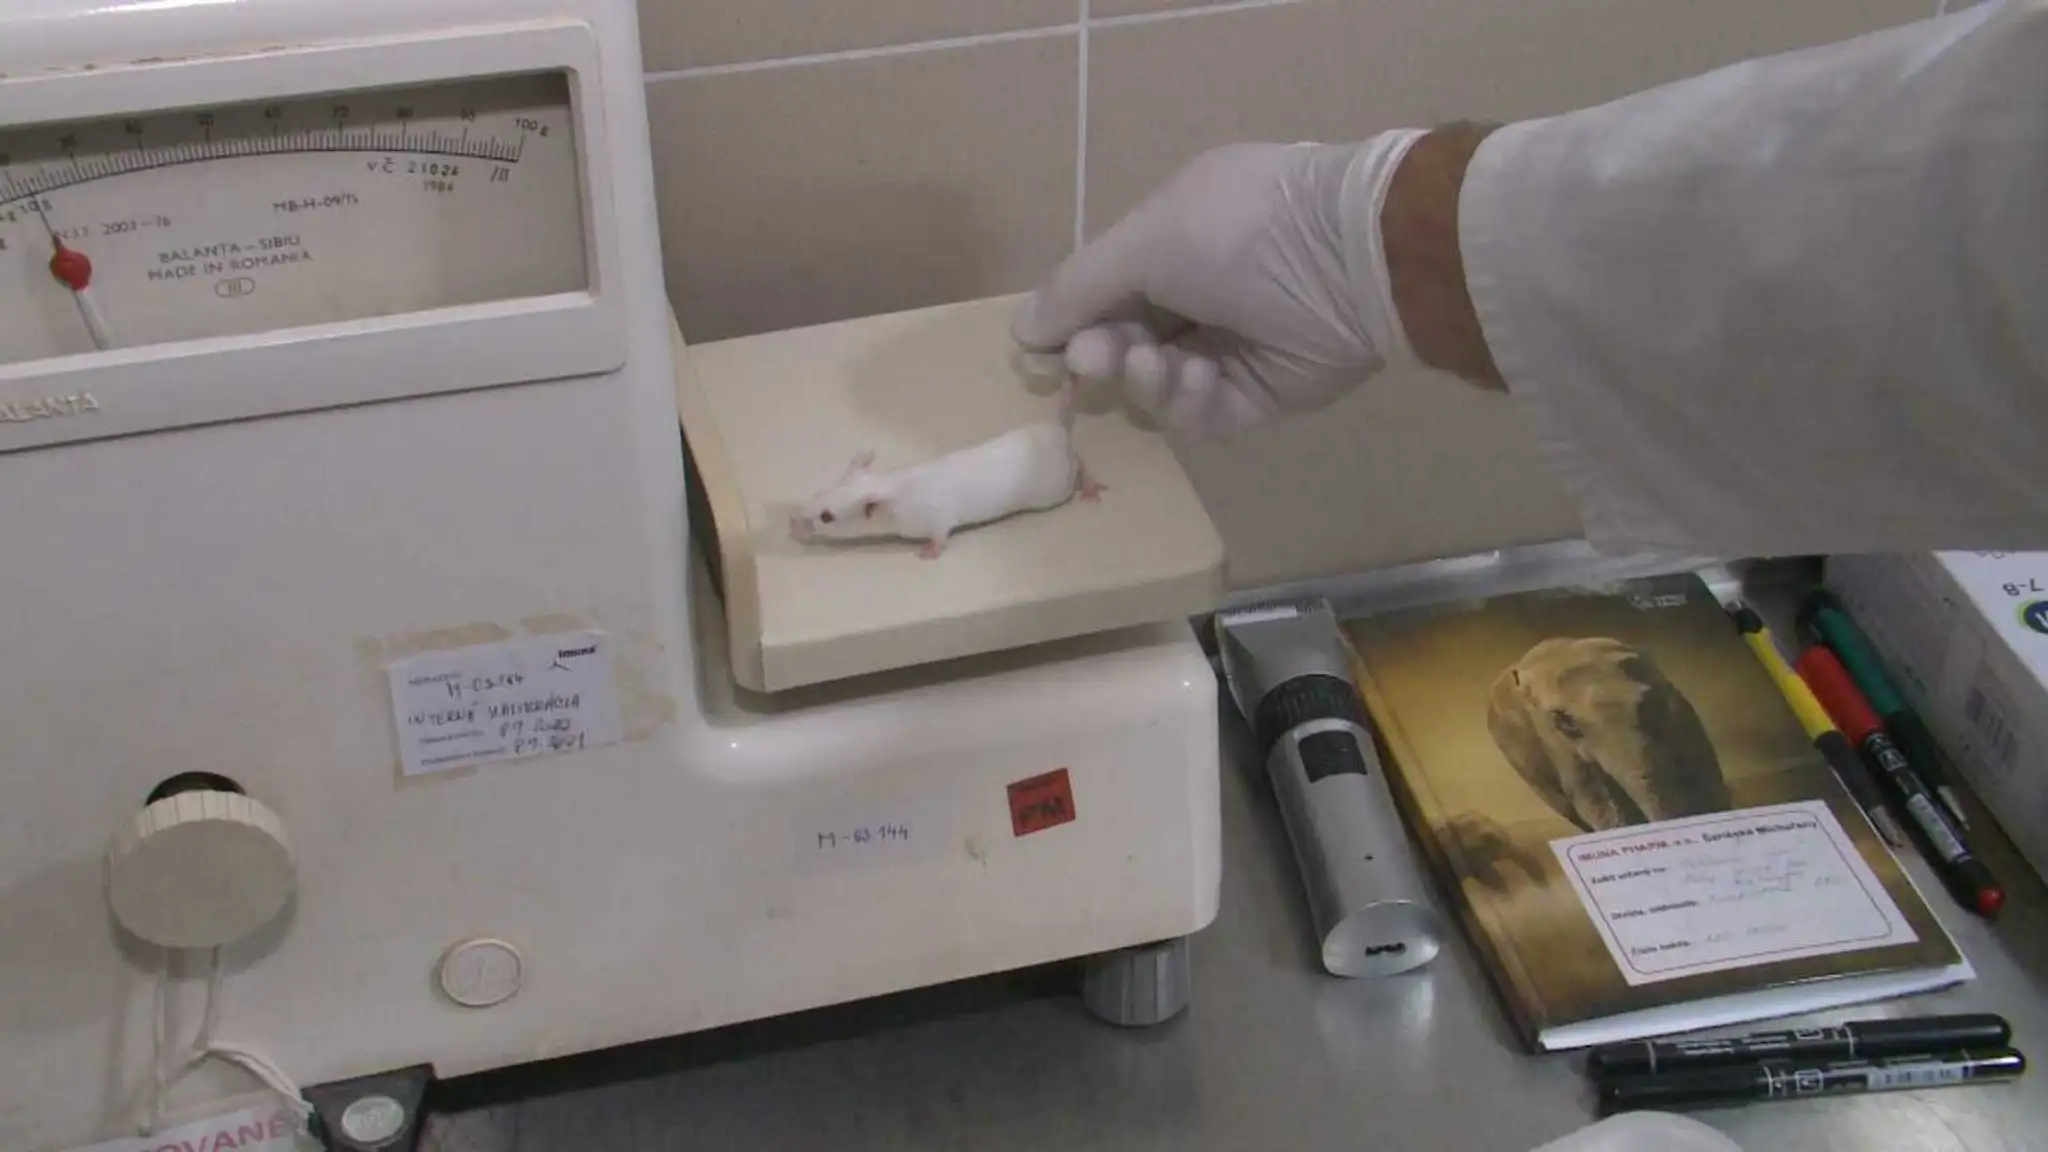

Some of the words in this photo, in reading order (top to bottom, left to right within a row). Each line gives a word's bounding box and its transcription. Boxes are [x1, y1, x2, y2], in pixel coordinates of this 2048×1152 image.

[158, 242, 242, 264] BALANTA
[258, 234, 300, 250] SIBIU
[147, 267, 198, 282] MADE
[203, 262, 224, 276] IN
[230, 250, 314, 273] ROMANIA
